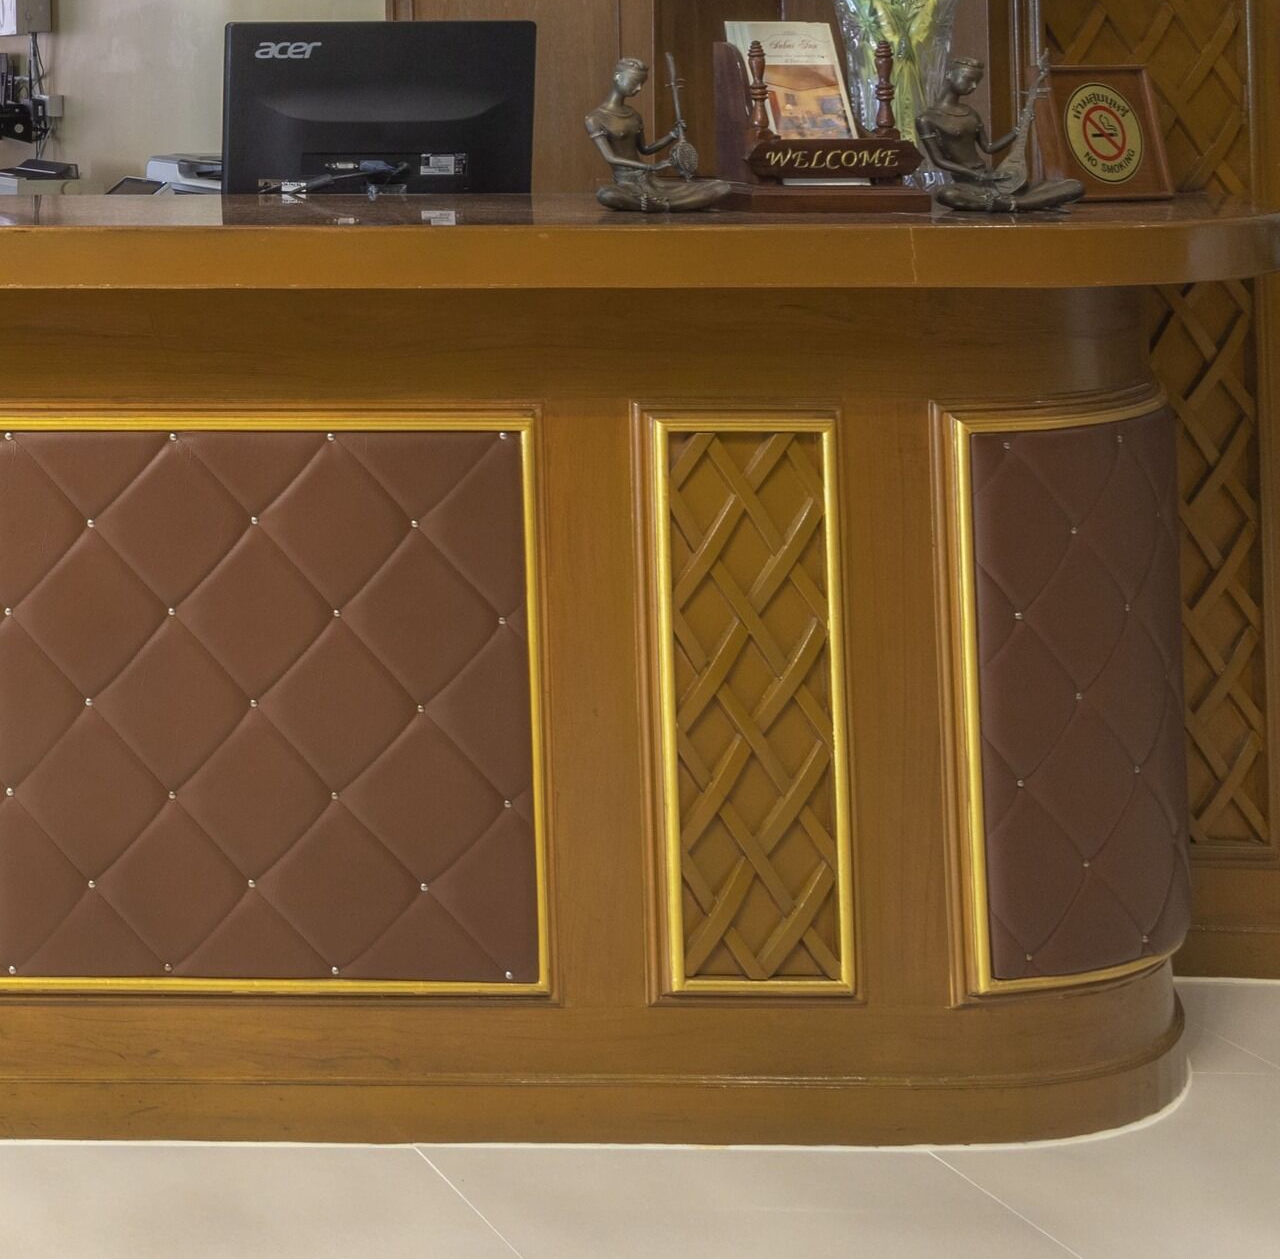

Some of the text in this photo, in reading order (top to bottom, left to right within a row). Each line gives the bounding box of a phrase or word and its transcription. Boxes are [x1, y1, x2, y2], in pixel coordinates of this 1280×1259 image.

[255, 42, 322, 59] acer
[765, 148, 900, 170] WELCOME
[1083, 149, 1135, 173] NO SMOKING
